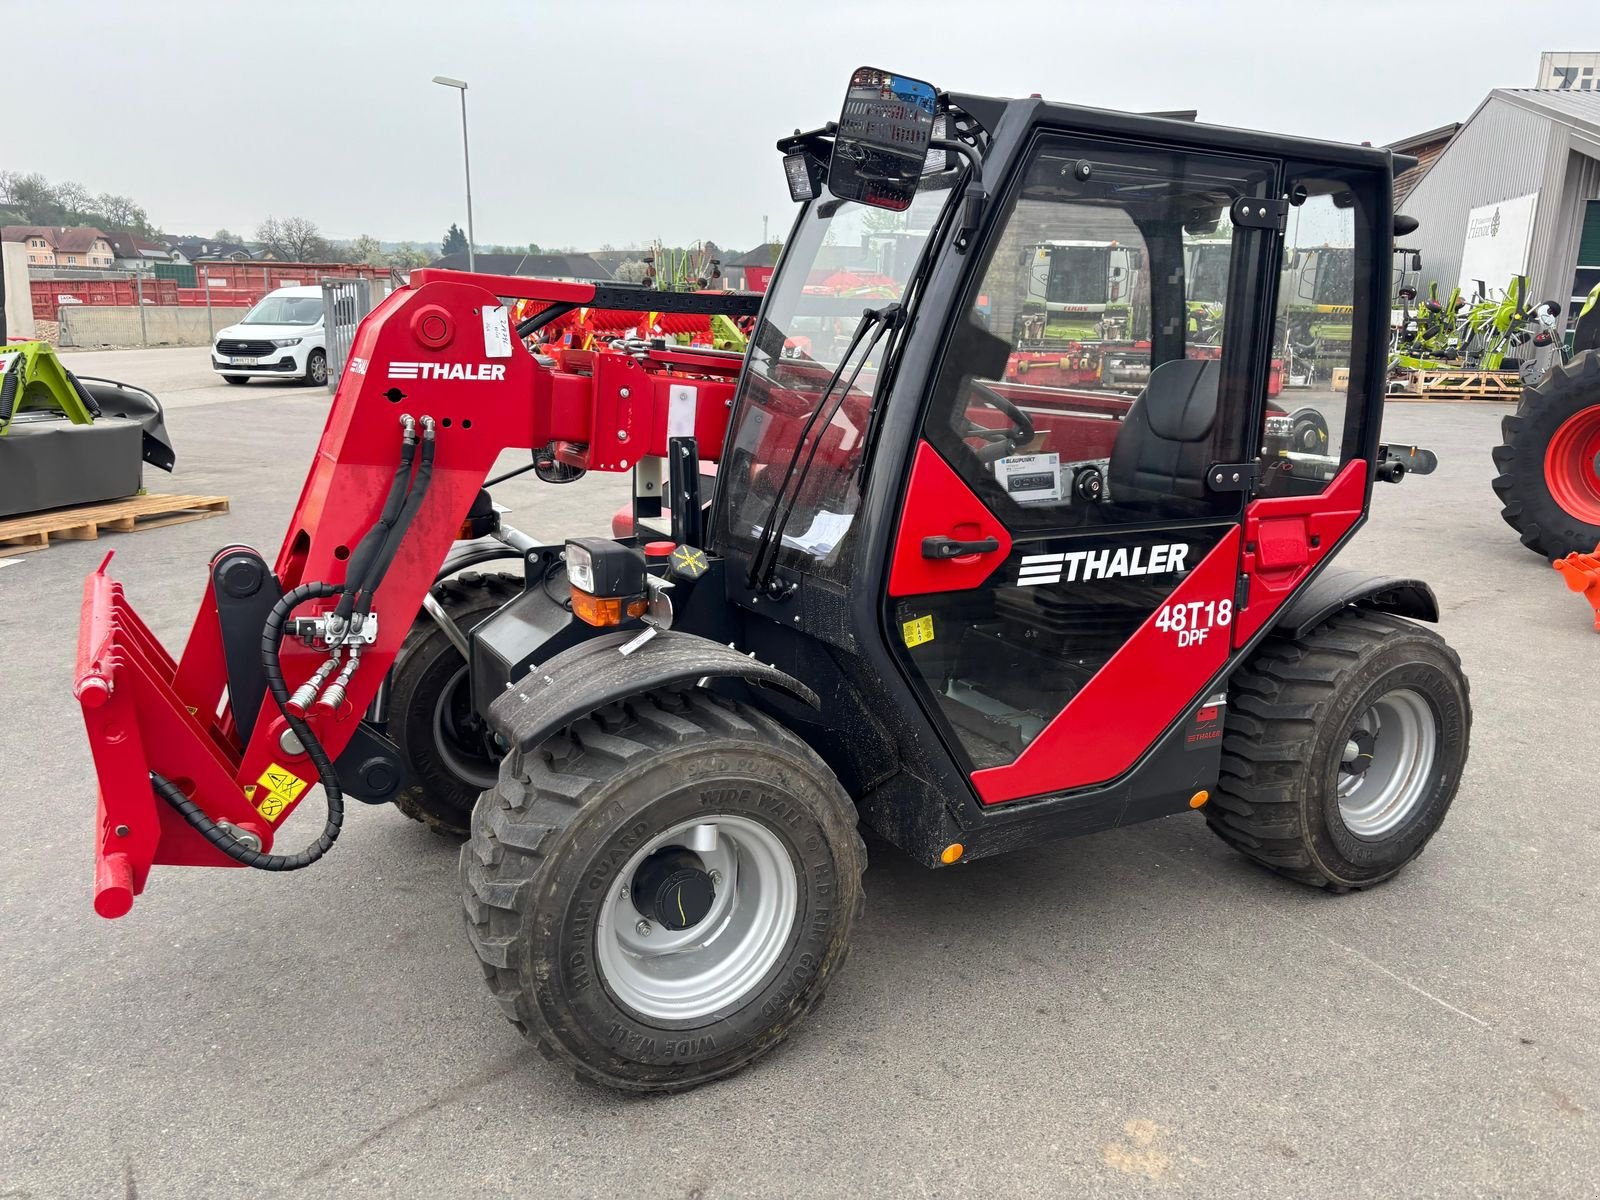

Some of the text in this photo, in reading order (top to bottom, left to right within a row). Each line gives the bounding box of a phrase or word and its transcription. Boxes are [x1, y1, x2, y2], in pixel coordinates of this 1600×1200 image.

[418, 362, 506, 381] THALER
[1064, 543, 1189, 582] THALER
[1155, 599, 1232, 633] 48T18
[1177, 628, 1209, 648] DPF
[1195, 730, 1221, 741] THALER
[700, 788, 803, 829] WIDE WALL
[588, 821, 649, 891] GUARD
